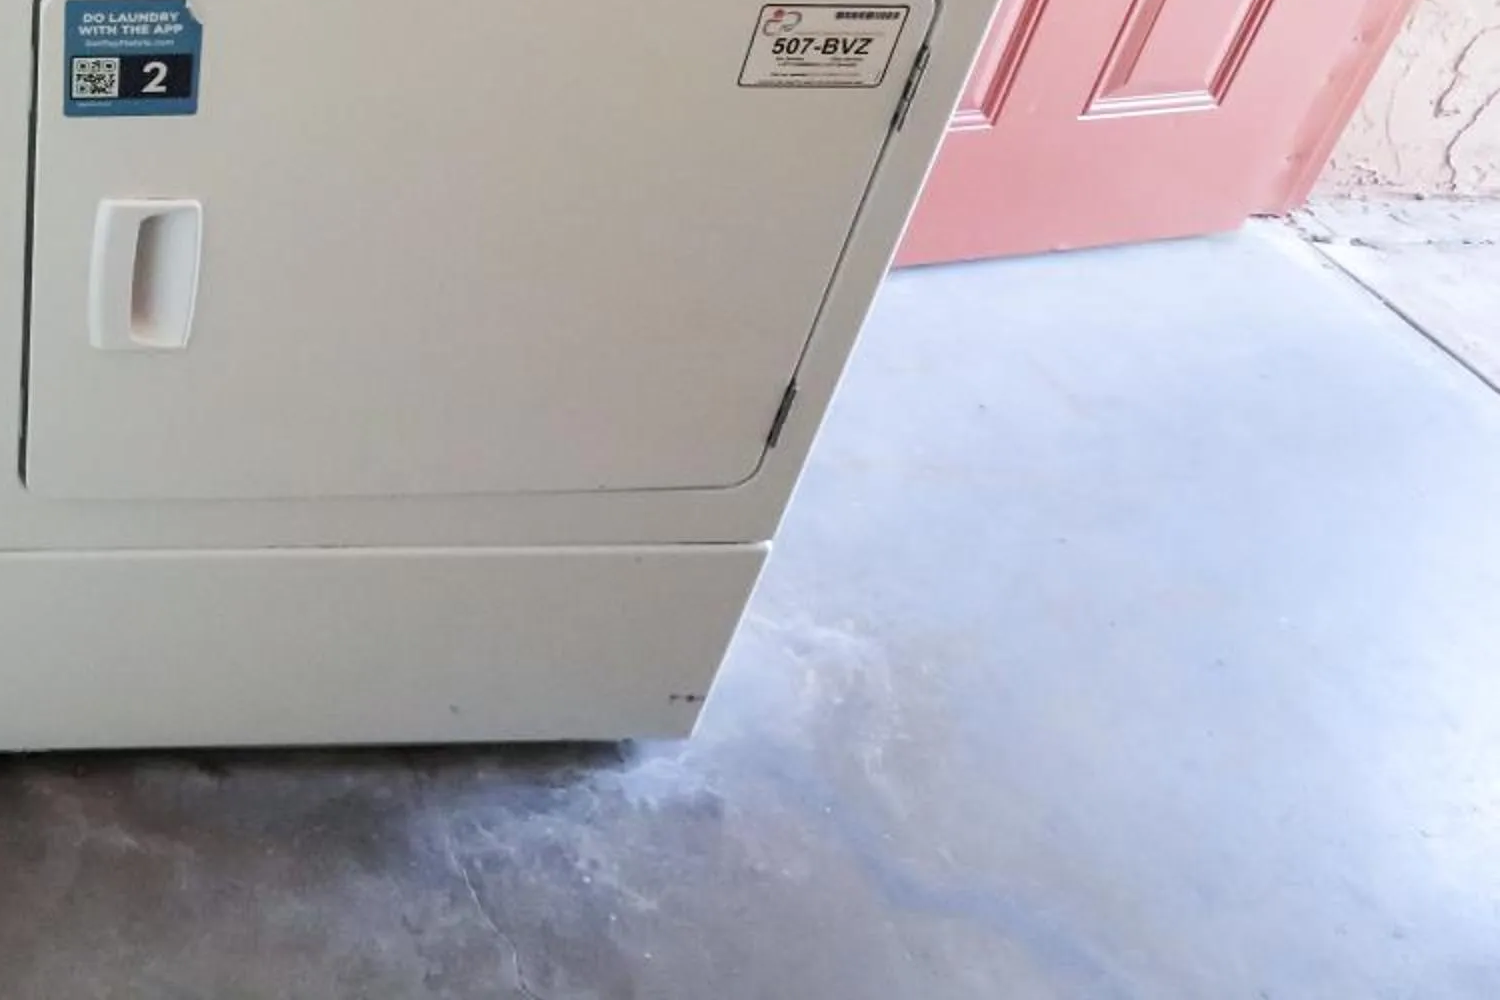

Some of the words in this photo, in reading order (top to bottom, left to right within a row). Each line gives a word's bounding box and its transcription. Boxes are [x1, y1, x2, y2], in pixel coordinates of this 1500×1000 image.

[83, 13, 105, 24] DO
[108, 11, 181, 23] LAUNDRY
[78, 25, 118, 36] WITH
[121, 24, 150, 35] THE
[153, 23, 184, 35] APP
[771, 37, 875, 55] 507-BVZ
[141, 61, 169, 93] 2
